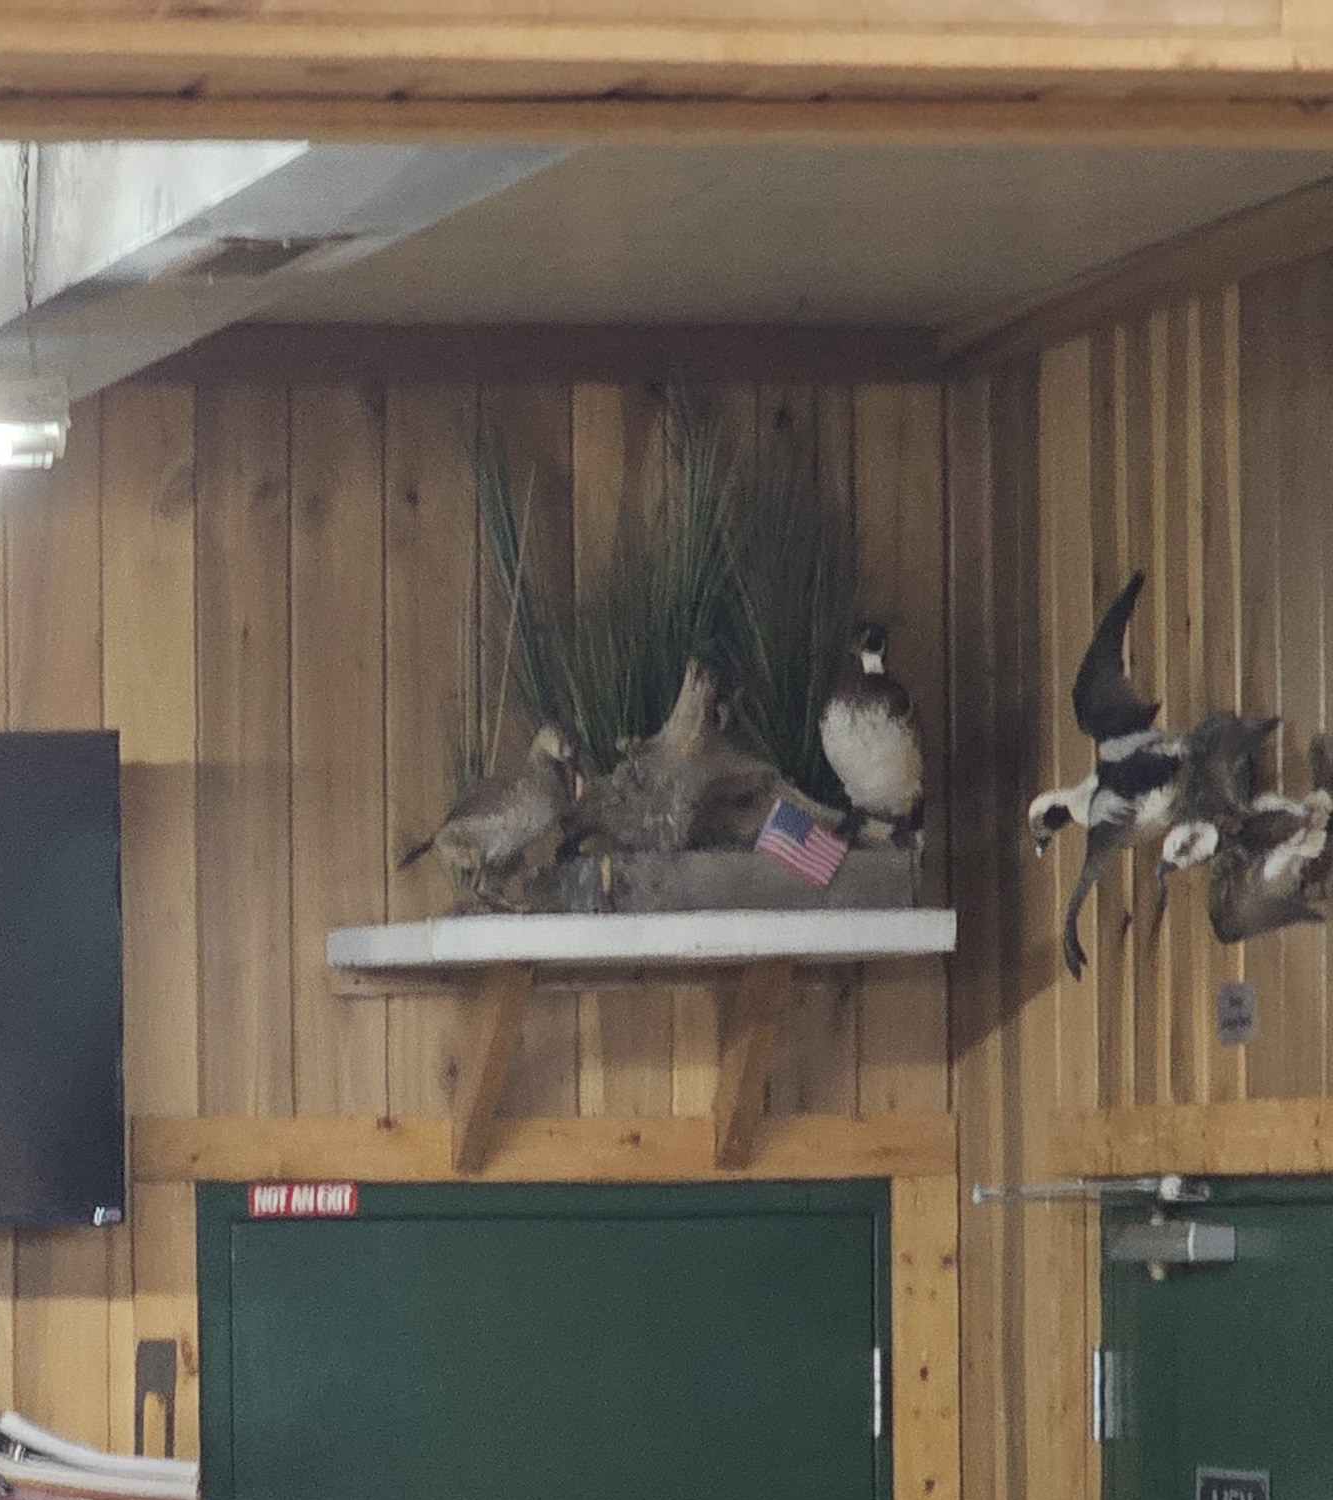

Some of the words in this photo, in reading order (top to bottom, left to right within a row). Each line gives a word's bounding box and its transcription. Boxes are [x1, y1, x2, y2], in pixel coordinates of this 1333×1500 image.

[254, 1184, 288, 1214] NOT
[291, 1184, 315, 1213] AN
[316, 1184, 352, 1214] EXIT
